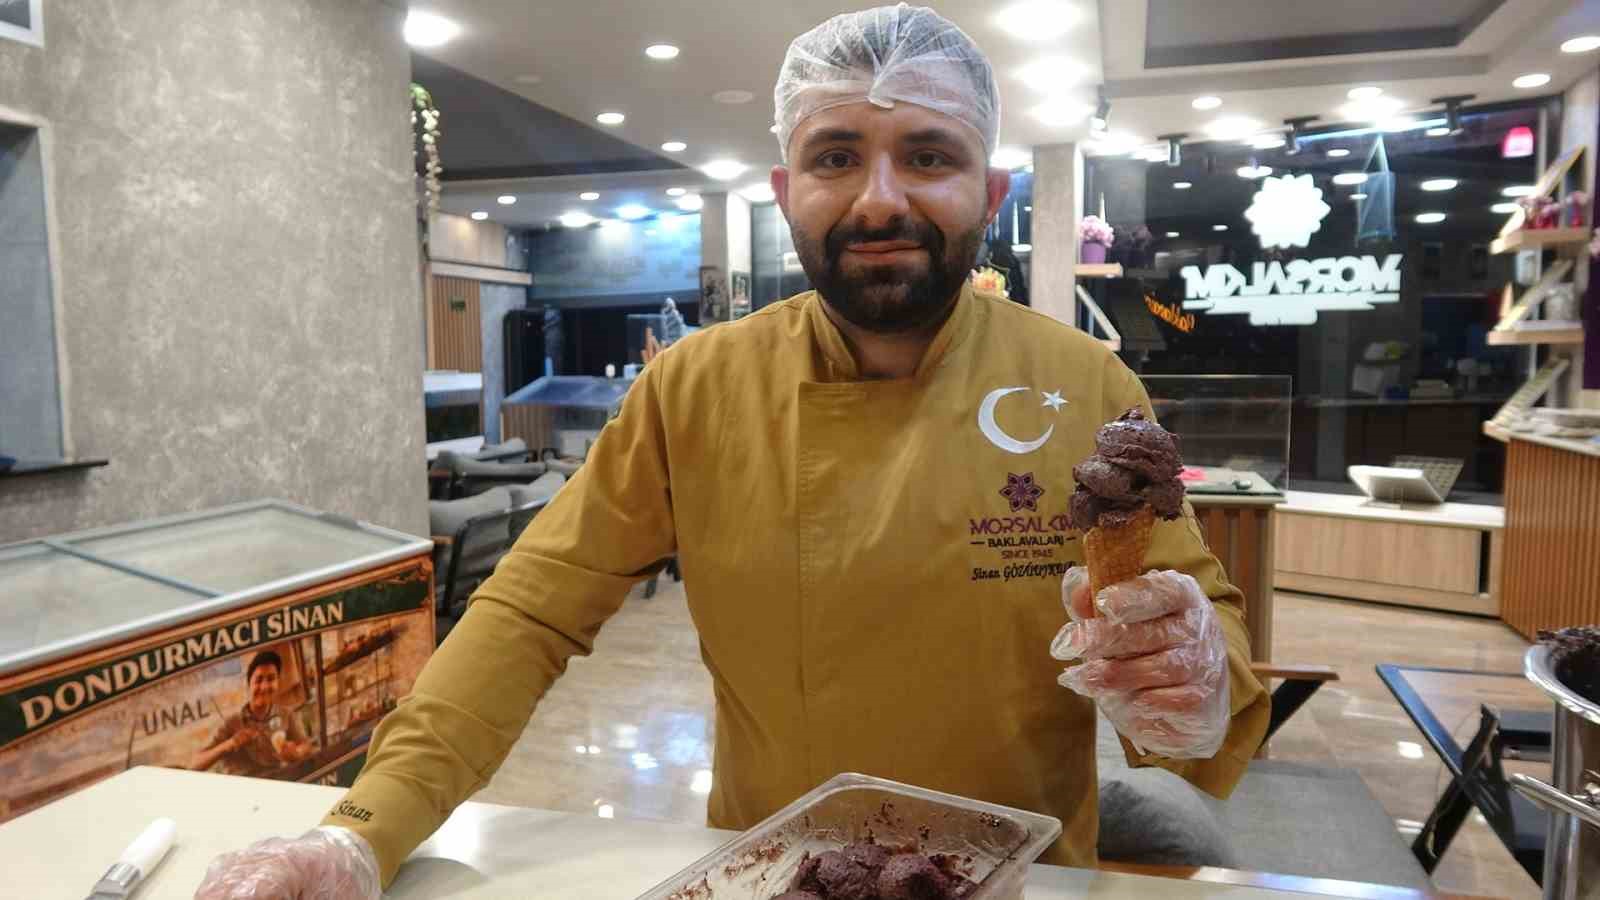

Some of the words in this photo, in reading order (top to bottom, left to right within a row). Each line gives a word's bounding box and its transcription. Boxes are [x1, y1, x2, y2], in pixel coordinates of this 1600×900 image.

[987, 535, 1065, 548] BAKLAVALARI
[20, 619, 260, 729] DONDURMACI
[266, 604, 345, 638] SİNAN
[141, 700, 210, 737] UNAL
[330, 799, 374, 823] Sinan
